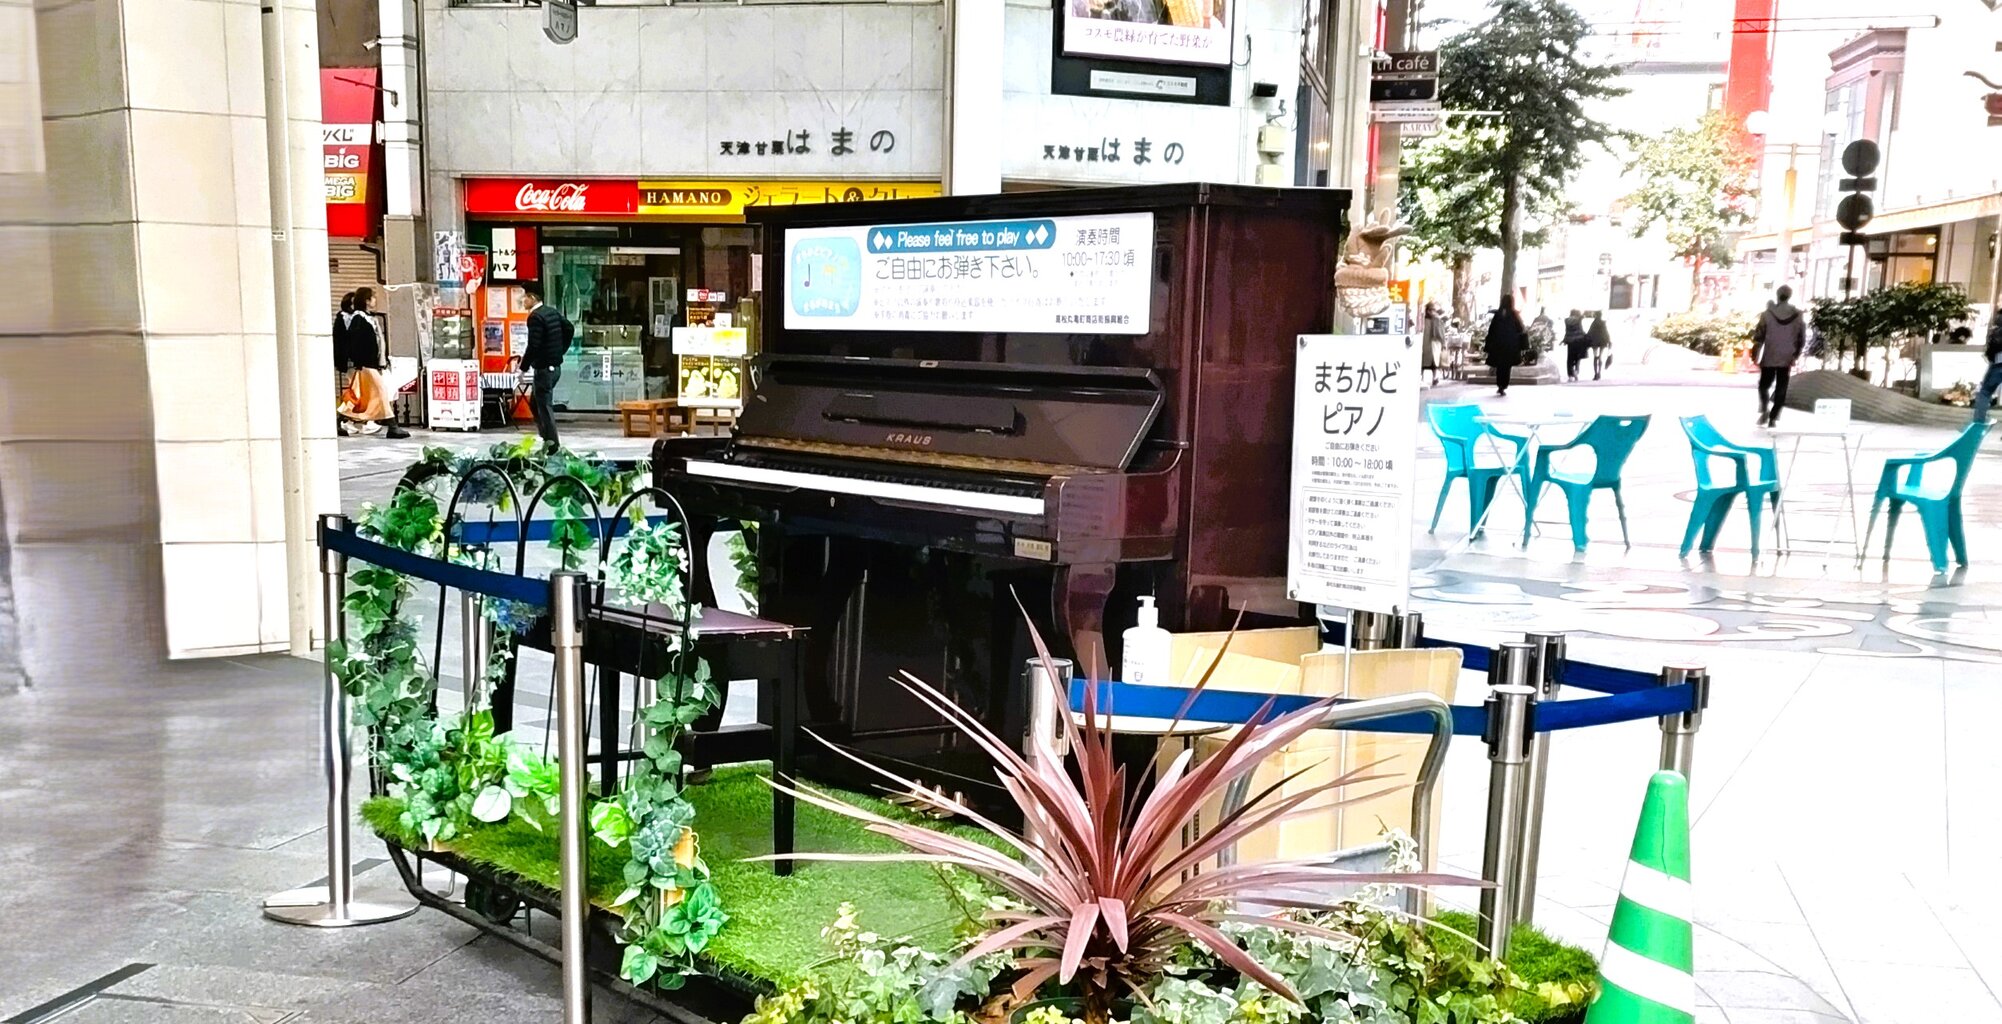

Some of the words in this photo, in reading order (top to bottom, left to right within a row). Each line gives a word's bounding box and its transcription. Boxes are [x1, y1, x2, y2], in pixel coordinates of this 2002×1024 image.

[1396, 56, 1430, 70] café
[787, 127, 895, 156] はまの
[324, 150, 359, 168] BIG
[1101, 137, 1185, 166] はまの
[325, 176, 355, 186] MEGA
[325, 185, 356, 198] BIG
[515, 183, 589, 211] Coca-Cola
[647, 191, 721, 205] HAMANO
[898, 231, 931, 248] Please
[934, 229, 955, 247] feel
[956, 229, 978, 246] free
[982, 230, 994, 245] to
[996, 227, 1020, 247] play
[1076, 227, 1120, 246] 演奏時間
[876, 255, 1039, 280] ご自由にお弾き下さい。
[1315, 361, 1401, 393] まちかど
[1323, 402, 1385, 436] ピアノ
[886, 433, 932, 446] KRAUS
[1325, 442, 1379, 452] ご自由にお弾きください
